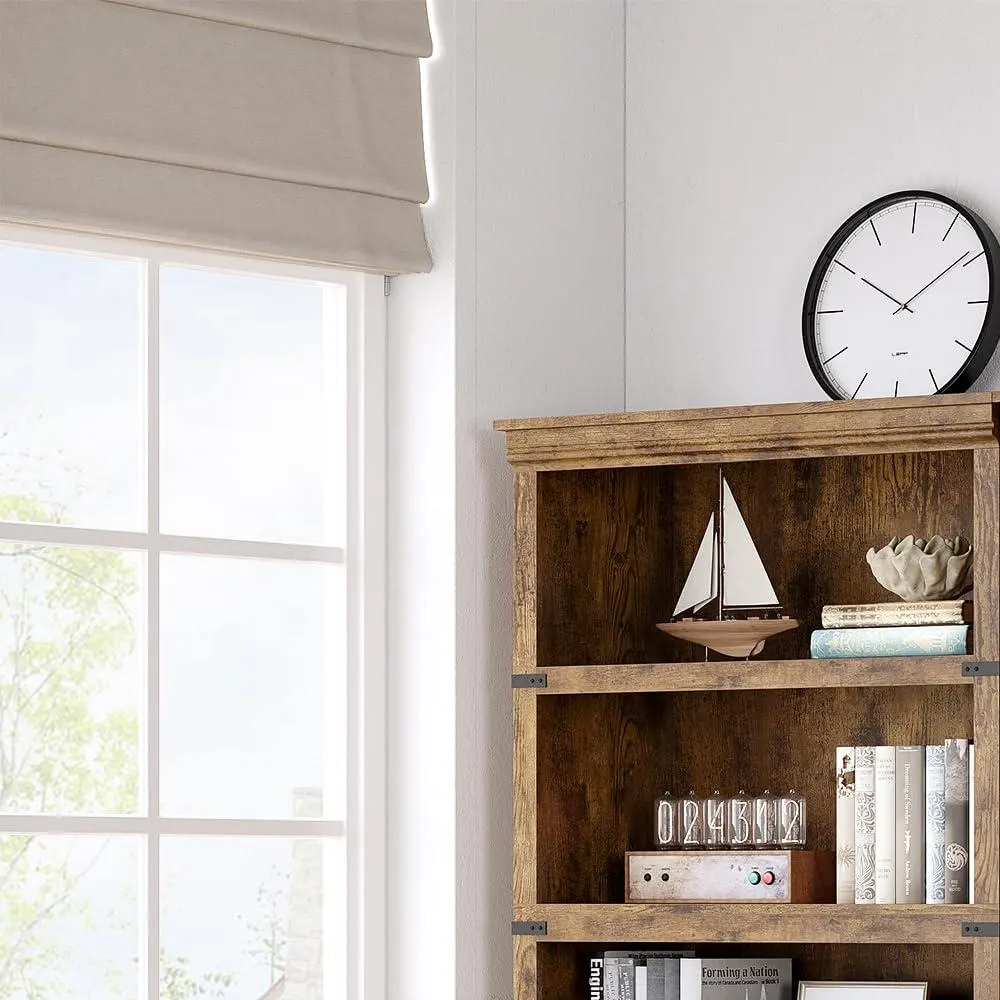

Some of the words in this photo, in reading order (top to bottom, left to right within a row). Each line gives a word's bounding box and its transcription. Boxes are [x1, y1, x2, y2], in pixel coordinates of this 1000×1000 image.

[702, 966, 740, 979] Forming
[750, 966, 778, 977] Nation
[622, 972, 632, 998] PUBLIC
